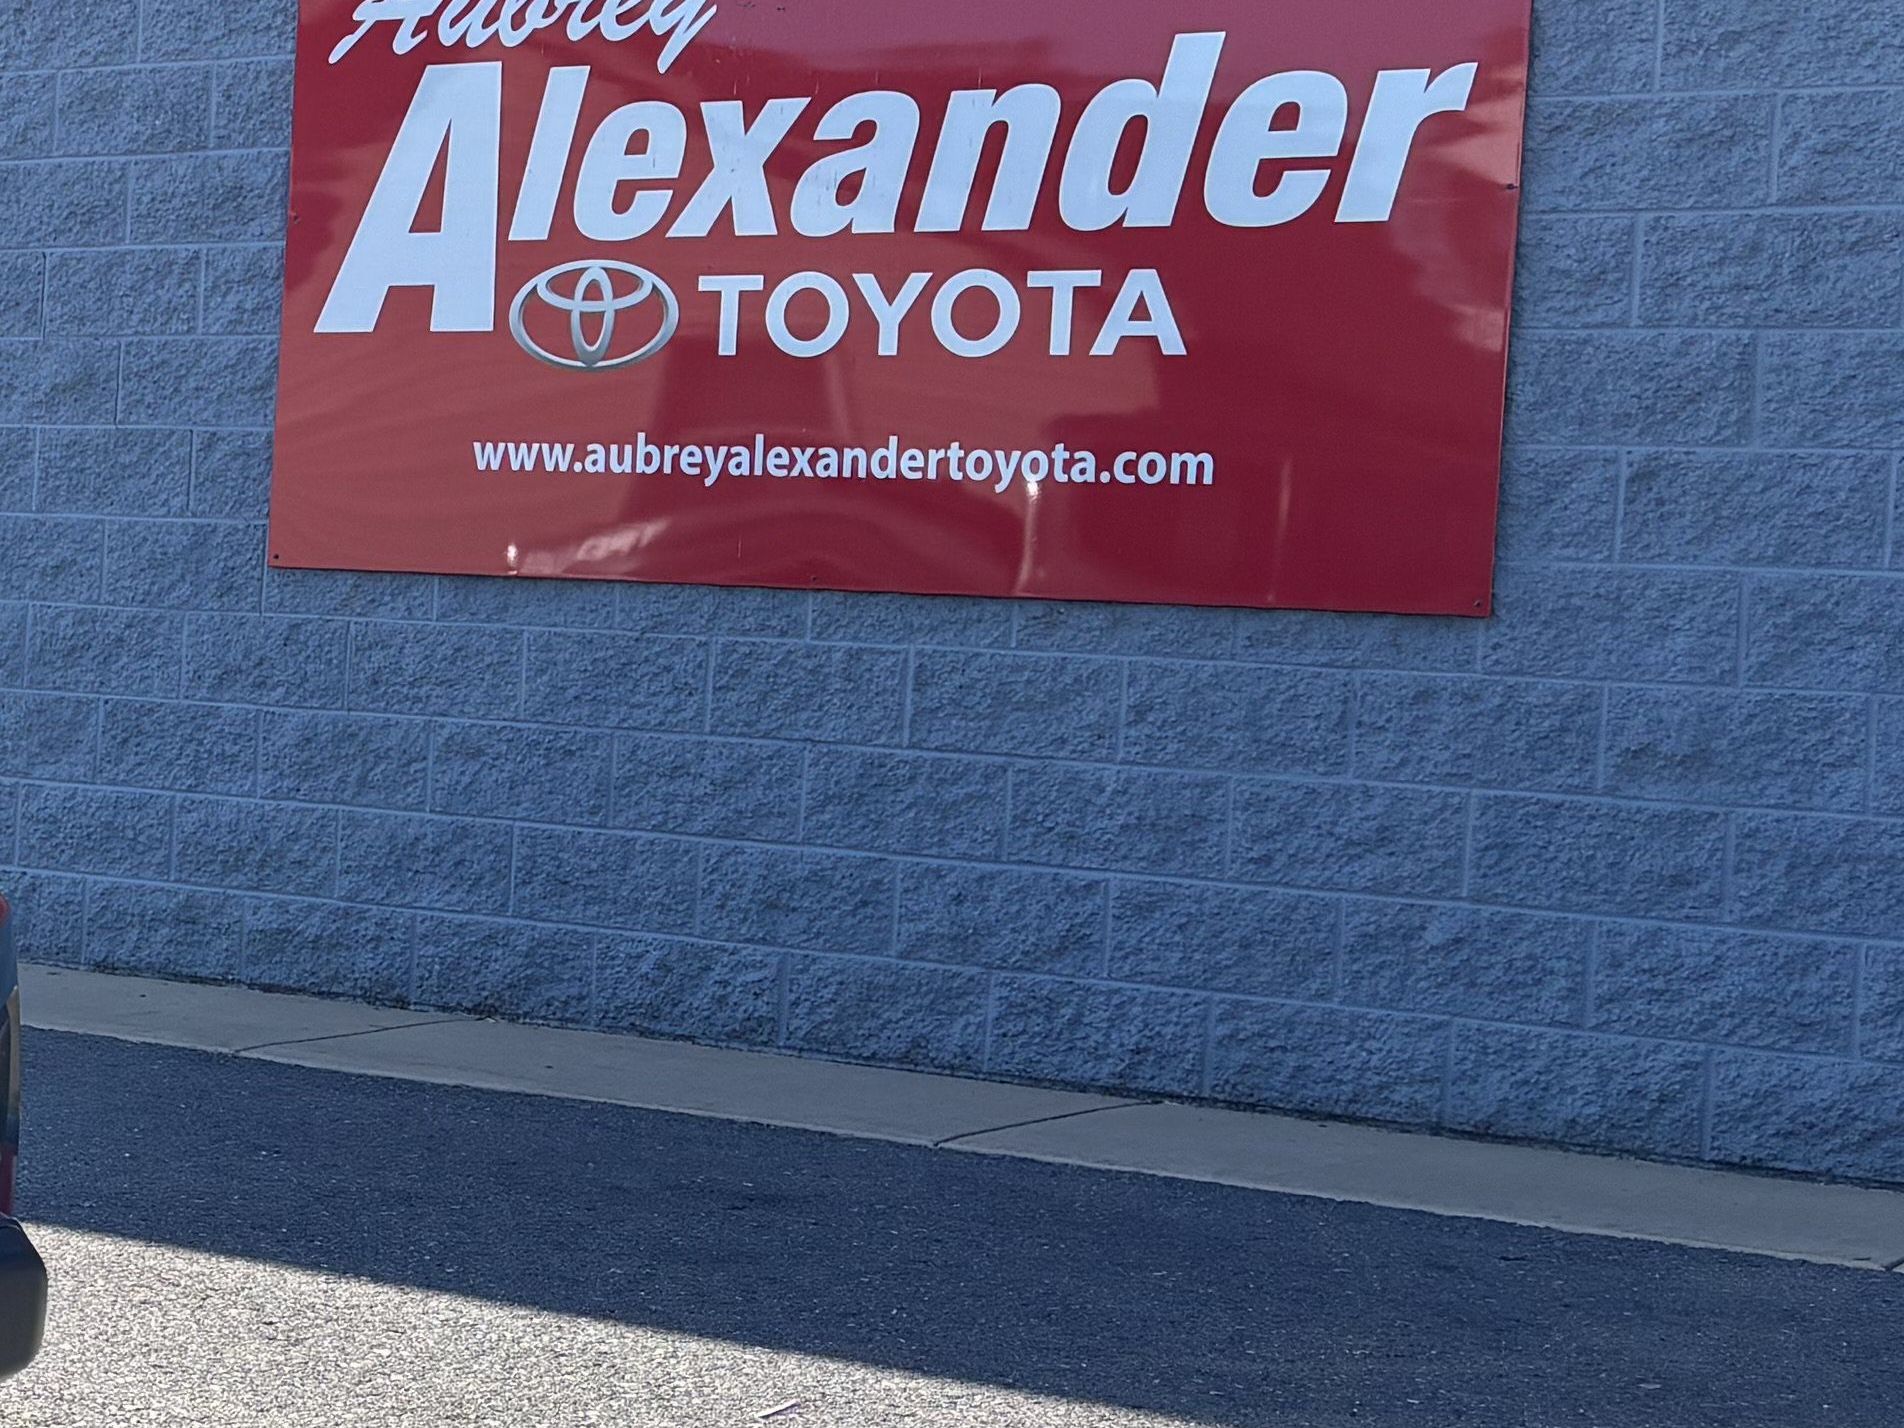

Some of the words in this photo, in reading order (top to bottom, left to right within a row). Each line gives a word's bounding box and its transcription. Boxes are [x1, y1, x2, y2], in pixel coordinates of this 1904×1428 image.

[313, 31, 1480, 333] Alexander
[697, 268, 1188, 358] TOYOTA
[472, 432, 1215, 495] www.aubreyalexandertoyota.com
